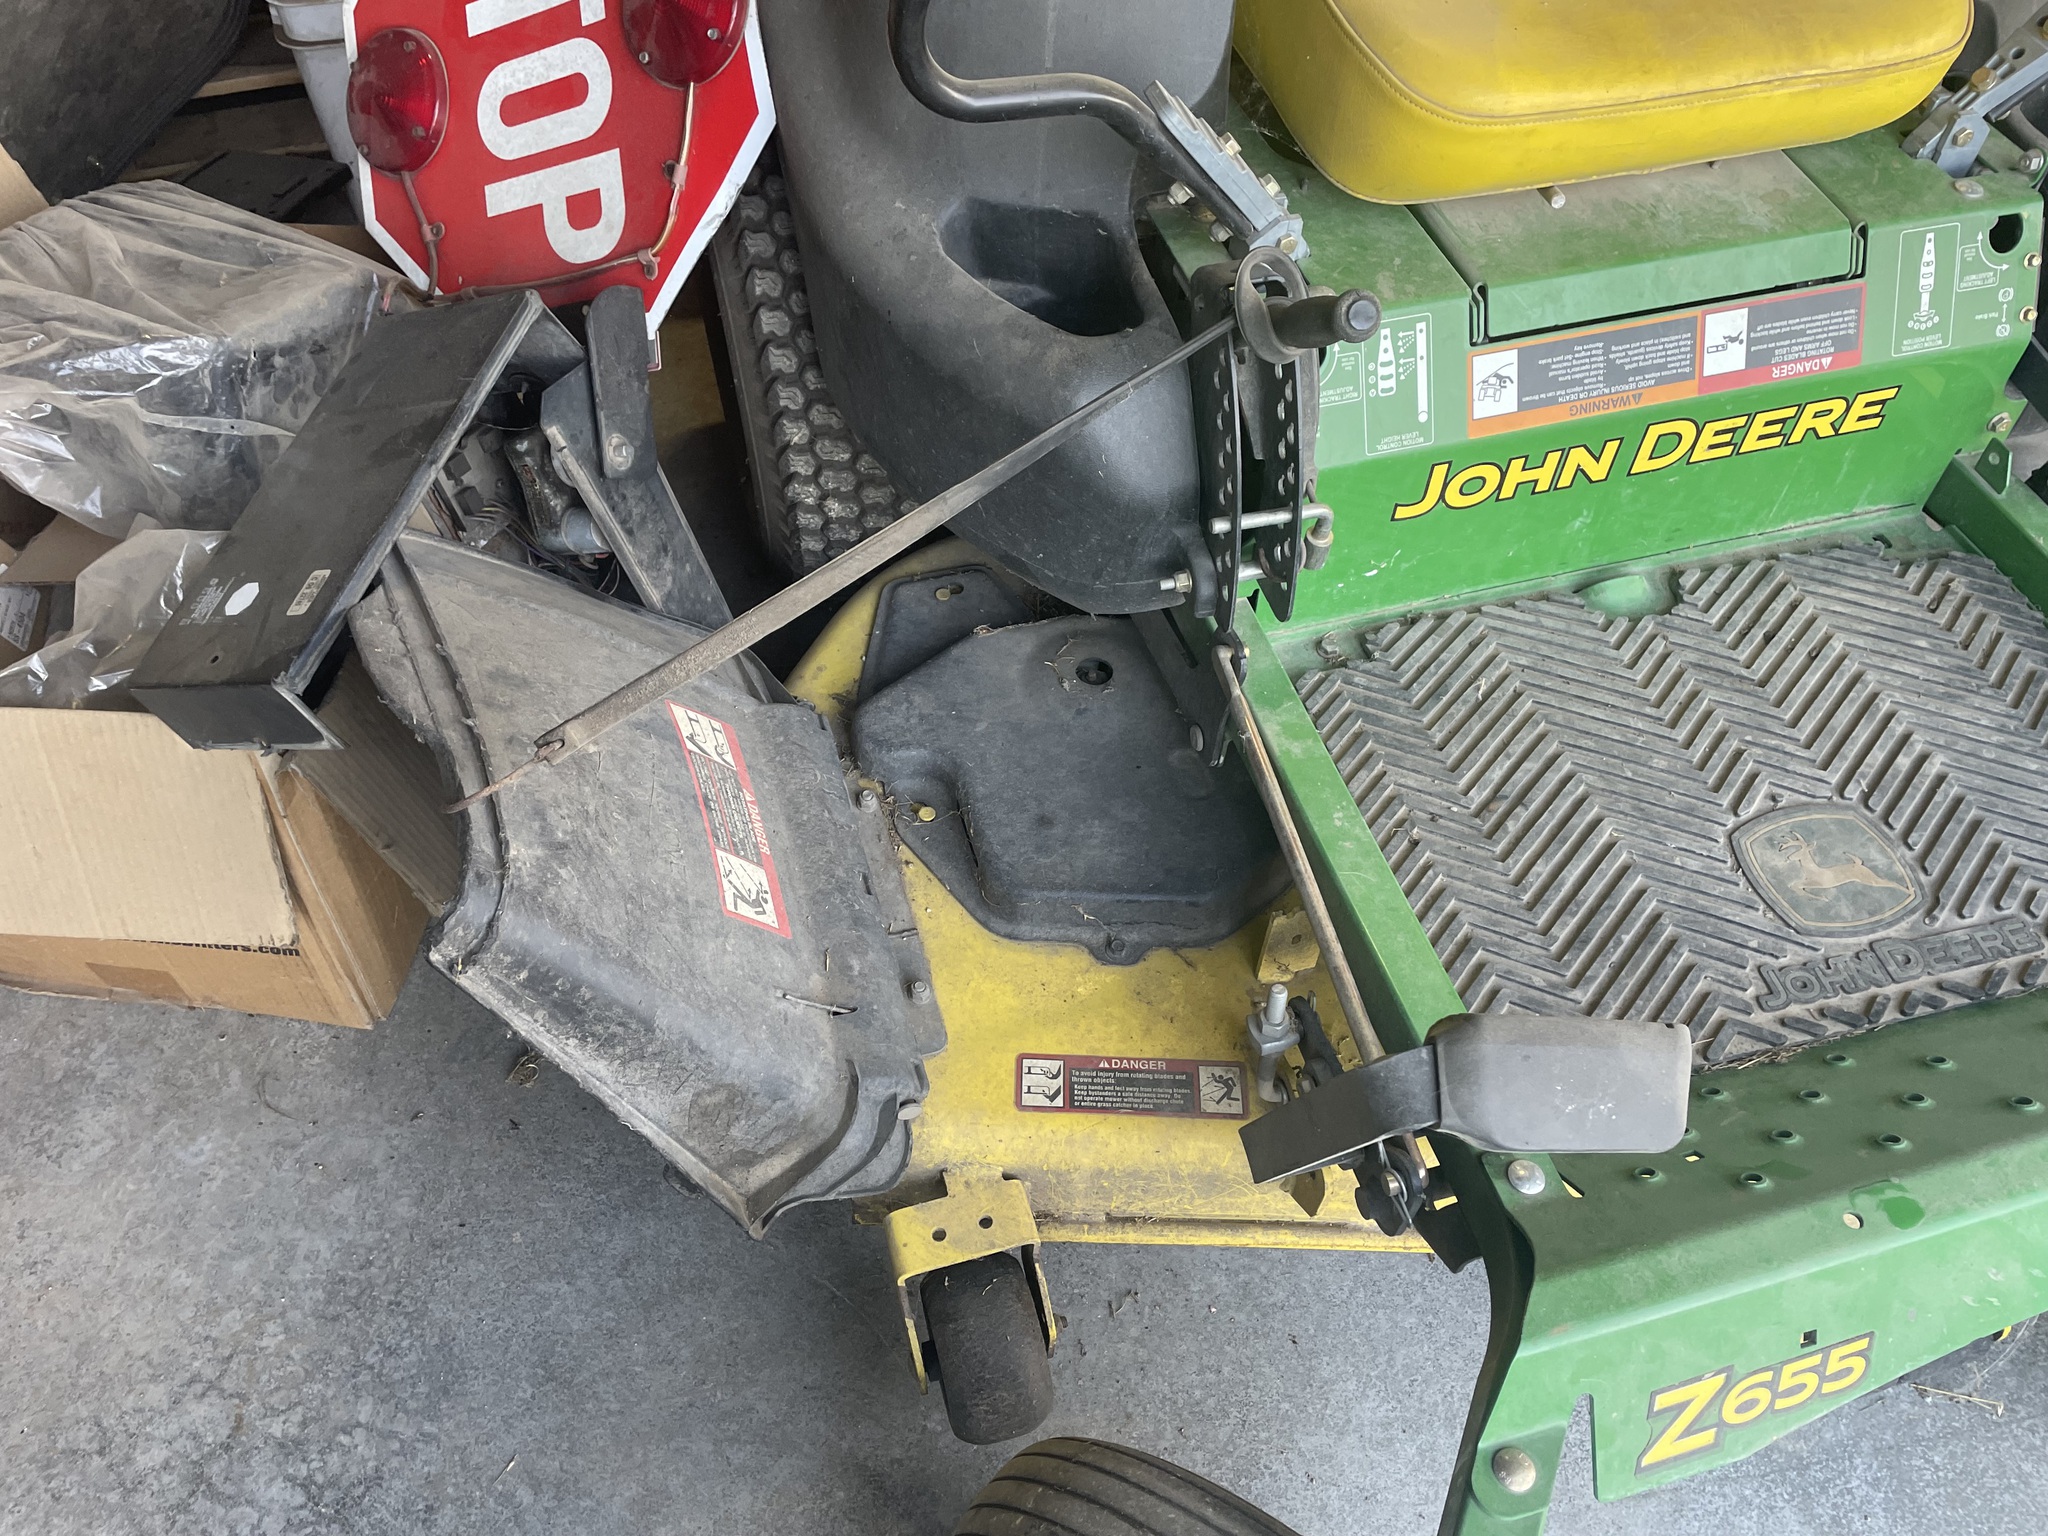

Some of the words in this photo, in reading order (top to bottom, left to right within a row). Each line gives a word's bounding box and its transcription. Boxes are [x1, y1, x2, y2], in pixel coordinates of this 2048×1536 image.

[1803, 341, 1819, 350] ARMS
[1819, 338, 1831, 347] OFF
[1774, 346, 1789, 355] LEGS
[1790, 344, 1803, 352] AND
[1807, 345, 1834, 356] ROTATING
[1770, 355, 1782, 363] CUT
[1783, 350, 1806, 361] BLADES
[1772, 358, 1819, 378] DANGER
[1611, 381, 1636, 393] SERIOUS
[1637, 378, 1655, 388] AVOID
[1579, 391, 1588, 399] OR
[1588, 387, 1609, 397] INJURY
[1319, 393, 1341, 403] TRACKI
[1558, 392, 1577, 403] DEATH
[1569, 394, 1629, 417] WARNING
[1380, 434, 1400, 444] HEIGHT
[1401, 430, 1418, 439] LEVER
[1376, 440, 1401, 451] CONTROL
[1402, 436, 1423, 446] MOTION
[1391, 437, 1625, 521] JOHN
[1627, 386, 1902, 476] DEERE
[746, 802, 770, 854] DANGER
[1760, 951, 1891, 1011] JOHN
[1873, 922, 2038, 982] DEERE
[1111, 1058, 1166, 1070] DANGER
[1088, 1089, 1116, 1097] bystanders
[1637, 1334, 1873, 1472] Z655
